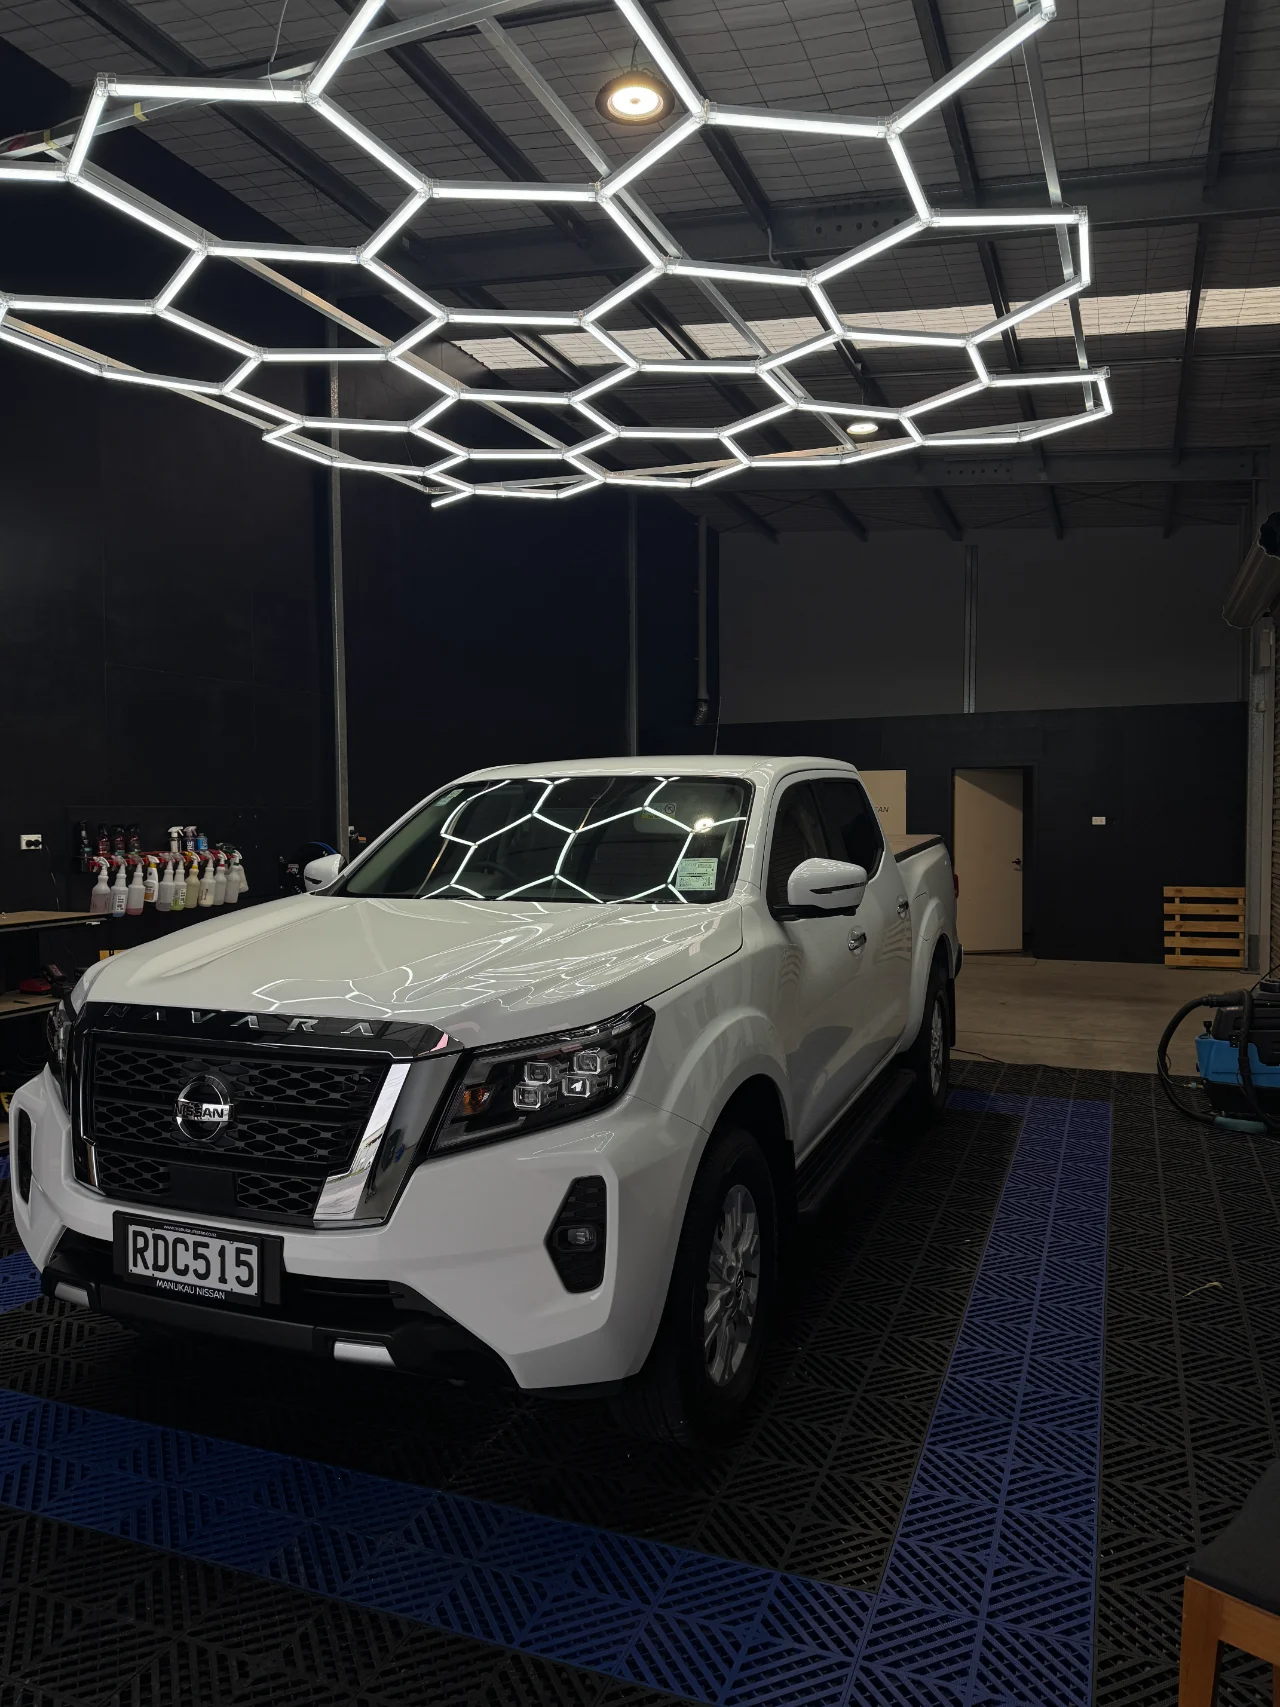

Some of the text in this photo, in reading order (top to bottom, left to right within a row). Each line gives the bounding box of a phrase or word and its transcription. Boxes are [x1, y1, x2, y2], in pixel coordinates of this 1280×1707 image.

[103, 1004, 376, 1036] NAVARA
[174, 1100, 224, 1119] NISSAN
[132, 1229, 254, 1288] RDC515
[156, 1279, 226, 1300] MANUKAU NISSAN
